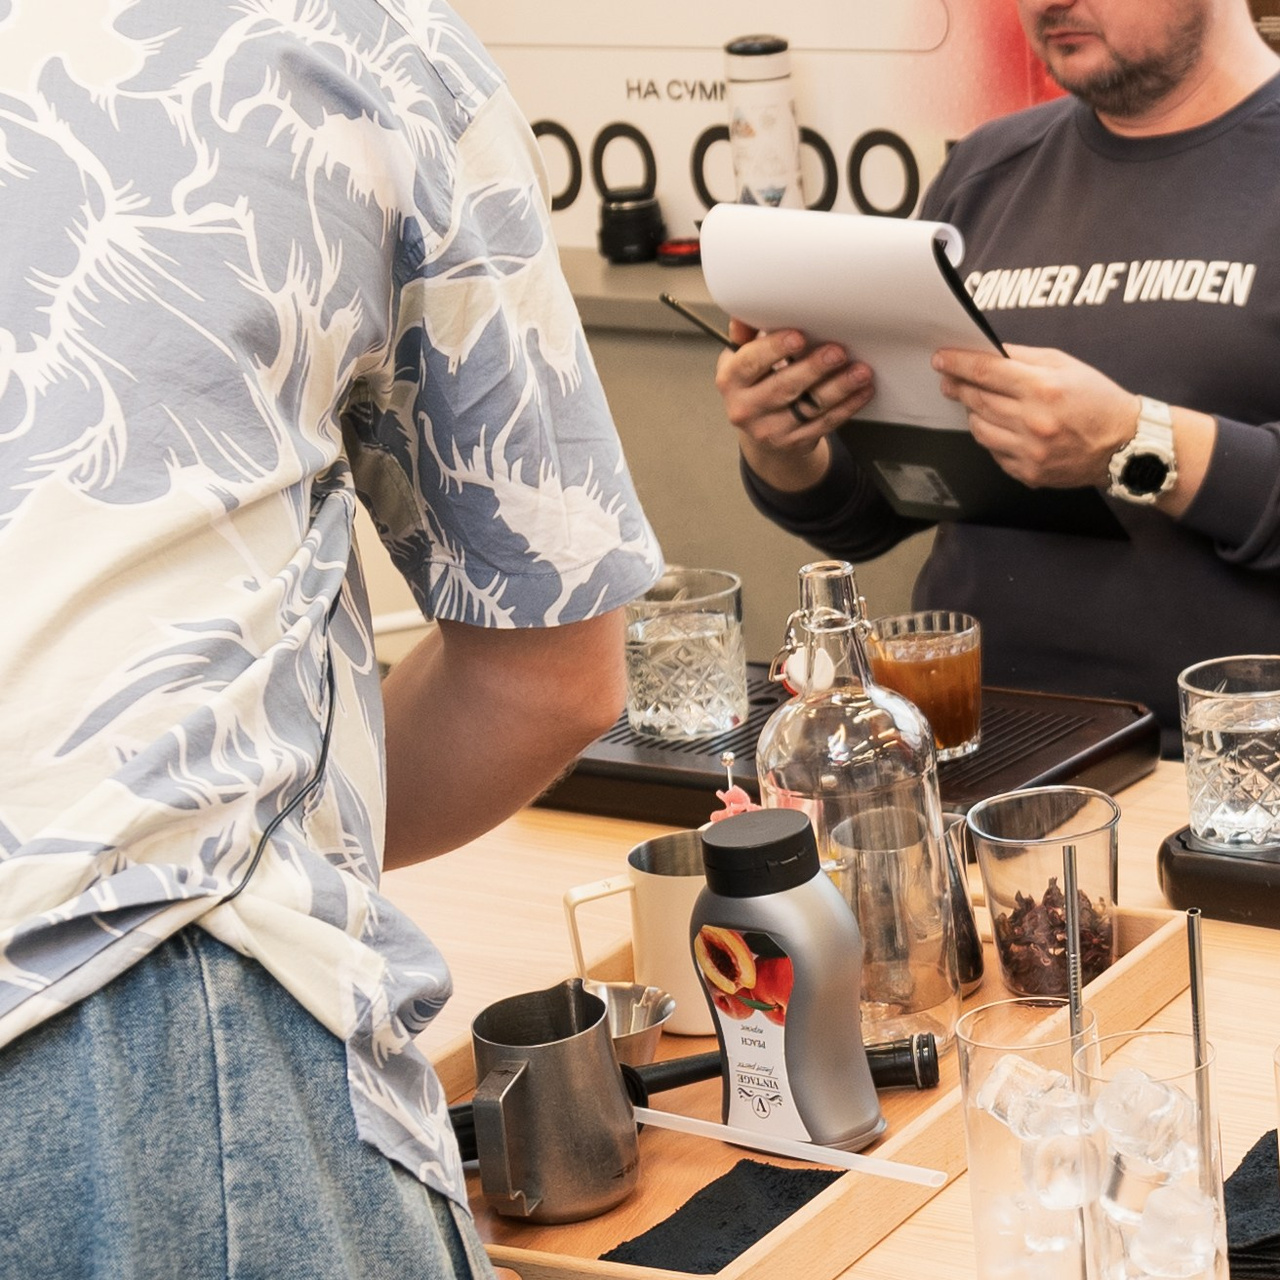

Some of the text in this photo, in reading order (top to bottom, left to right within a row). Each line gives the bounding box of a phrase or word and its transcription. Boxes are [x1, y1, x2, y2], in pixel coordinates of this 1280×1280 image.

[626, 78, 727, 102] НА СУМ
[1073, 262, 1127, 307] AF
[1123, 260, 1256, 307] VINDEN
[741, 1037, 766, 1049] PEACH
[737, 1073, 779, 1090] VINTAGE
[757, 1098, 767, 1113] V
